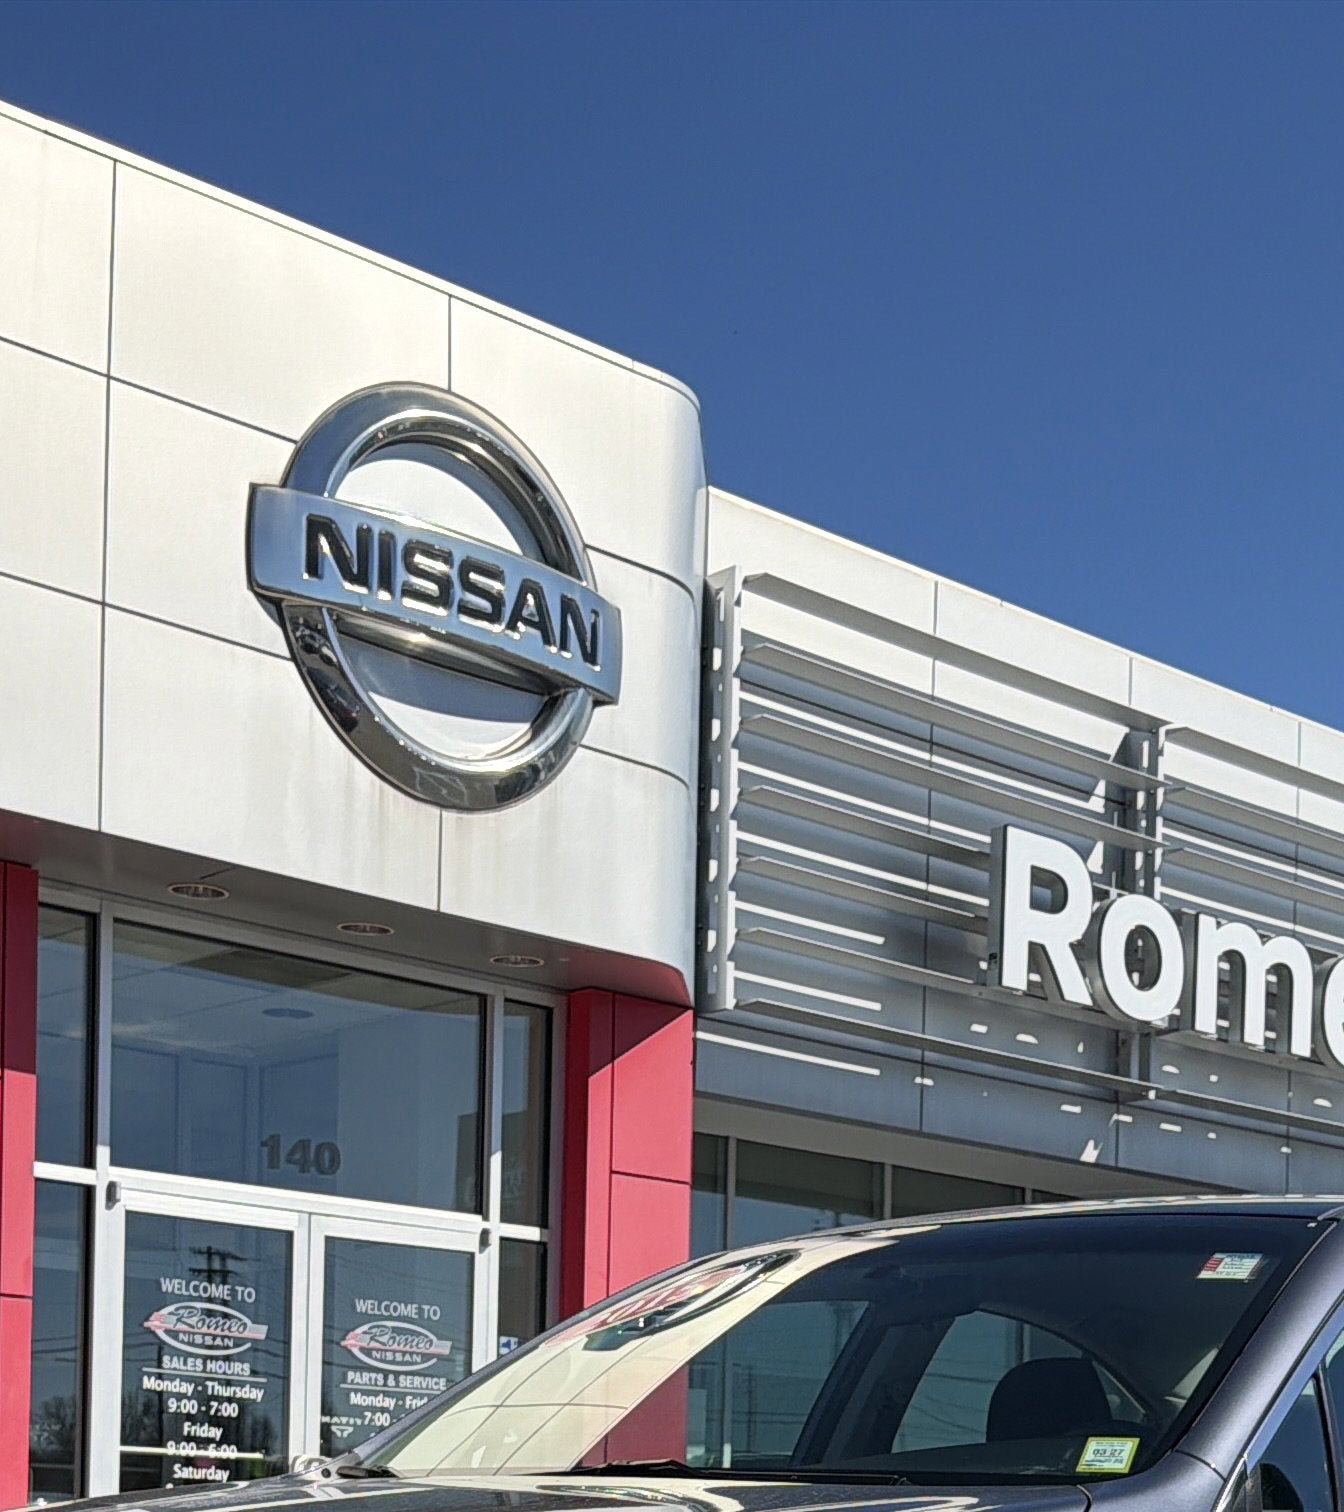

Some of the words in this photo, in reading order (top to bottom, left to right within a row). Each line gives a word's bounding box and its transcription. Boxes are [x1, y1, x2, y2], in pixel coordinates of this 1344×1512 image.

[301, 512, 601, 671] NISSAN
[260, 1133, 341, 1175] 140
[160, 1277, 232, 1301] WELCOME
[235, 1285, 256, 1303] TO
[355, 1298, 419, 1318] WELCOME
[421, 1304, 441, 1320] TO
[171, 1306, 248, 1334] Romeo
[178, 1333, 234, 1348] NISSAN
[362, 1325, 434, 1350] Romeo
[162, 1355, 203, 1372] SALES
[206, 1359, 251, 1376] HOURS
[371, 1350, 422, 1363] NISSAN
[142, 1375, 195, 1396] Monday
[205, 1381, 265, 1402] Thursday
[347, 1371, 385, 1386] PARTS
[387, 1374, 396, 1387] &
[398, 1374, 447, 1390] SERVICE
[167, 1397, 198, 1415] 9:00
[209, 1401, 239, 1418] 7:00
[349, 1391, 397, 1411] Monday
[363, 1411, 391, 1427] 7:00
[183, 1421, 224, 1442] Friday
[172, 1463, 231, 1484] Saturday
